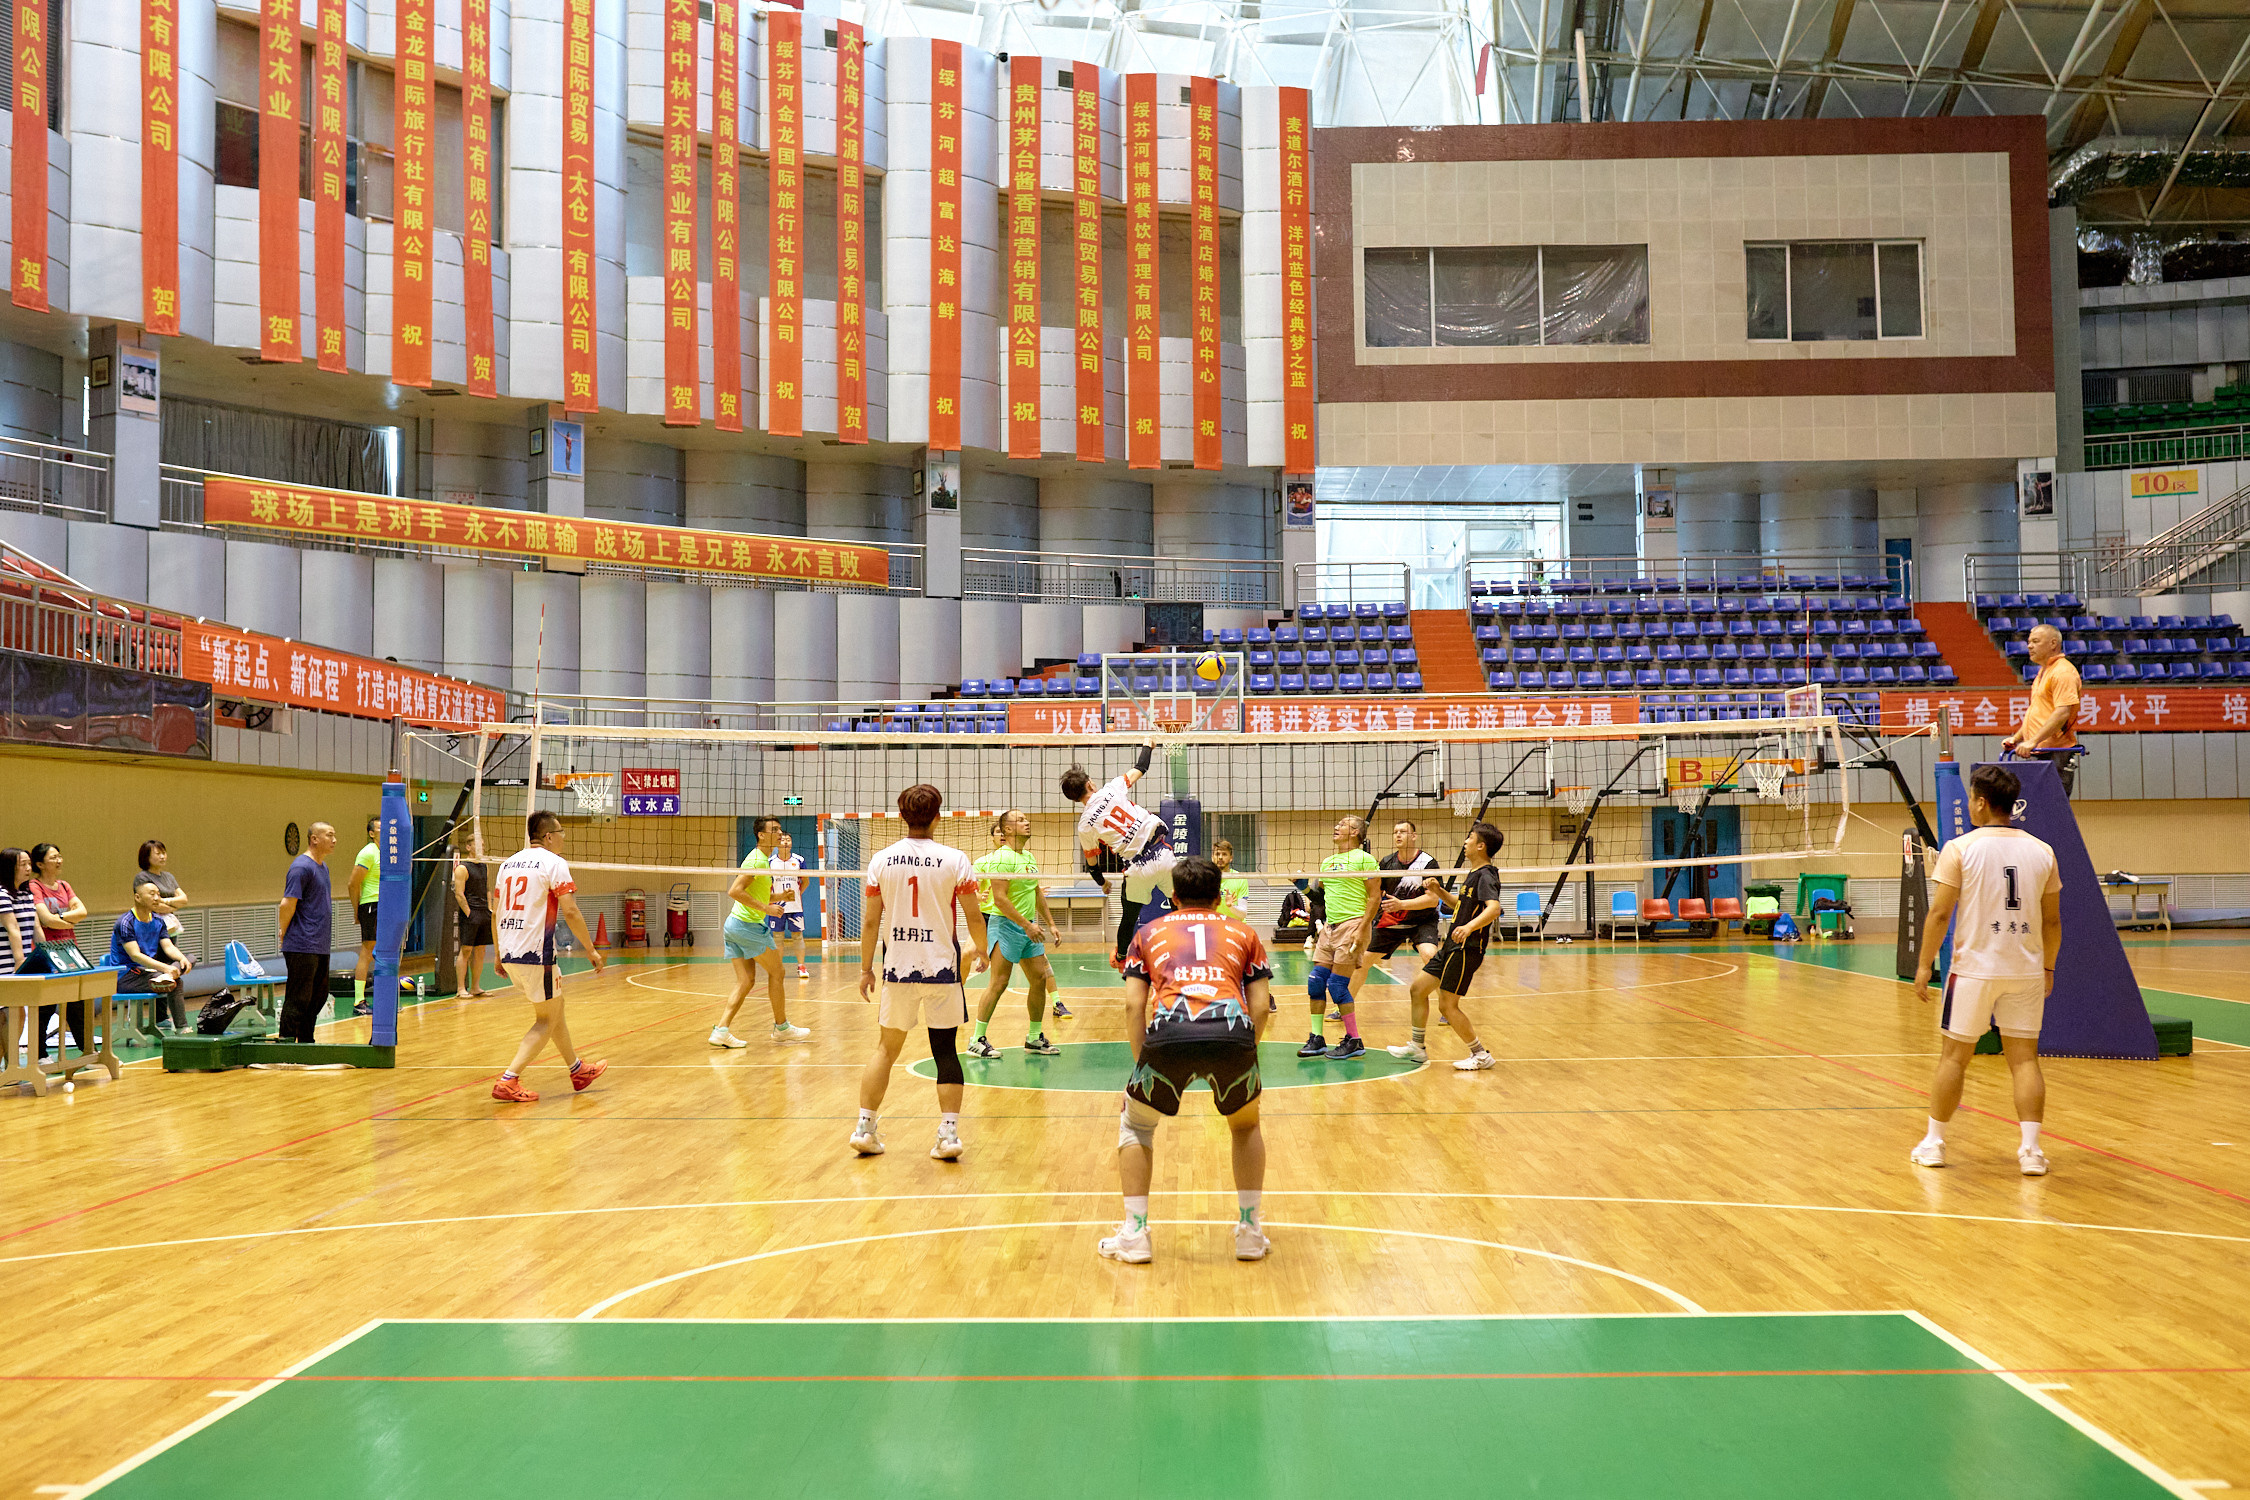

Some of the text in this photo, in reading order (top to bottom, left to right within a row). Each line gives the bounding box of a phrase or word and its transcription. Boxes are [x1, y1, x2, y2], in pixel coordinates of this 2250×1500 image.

[20, 0, 41, 292] 限公司 贺
[322, 0, 343, 356] 商贸有限公司 贺
[776, 40, 796, 400] 绥芬河金龙国际旅行社有限公司 祝
[842, 30, 862, 430] 太仓海之源国际贸易有限公司 贺
[936, 68, 956, 415] 绥芬河超富达海鲜 祝
[1013, 83, 1037, 422] 贵州茅台酱香酒营销有限公司 祝
[1077, 89, 1100, 426] 绥芬河欧亚凯盛贸易有限公司 祝
[1133, 101, 1154, 435] 绥芬河博雅餐饮管理有限公司 祝
[1197, 104, 1216, 437] 绥芬河数码港酒店婚庆礼仪中心 祝
[152, 287, 175, 318] 贺
[269, 316, 293, 345] 贺
[402, 324, 424, 346] 祝
[472, 355, 491, 381] 贺
[570, 371, 592, 398] 贺
[671, 385, 694, 411] 贺
[719, 391, 737, 417] 贺
[1290, 423, 1308, 440] 祝
[2139, 474, 2187, 493] 10 区
[250, 489, 860, 579] 球场上是对手 永不服输 战场上是兄弟 永不言败
[1905, 693, 2249, 728] 提高全民身水平 培
[643, 774, 676, 788] 禁止吸烟
[1679, 760, 1703, 782] B
[628, 798, 675, 813] 饮水点
[1103, 806, 1136, 837] 19
[887, 855, 943, 868] ZHANG.G.Y
[505, 876, 528, 911] 12
[907, 876, 919, 918] 1
[2003, 866, 2022, 911] 1
[893, 927, 934, 943] 牡丹江
[1187, 923, 1207, 961] 1
[50, 951, 68, 970] 6
[1174, 966, 1226, 982] 牡丹江
